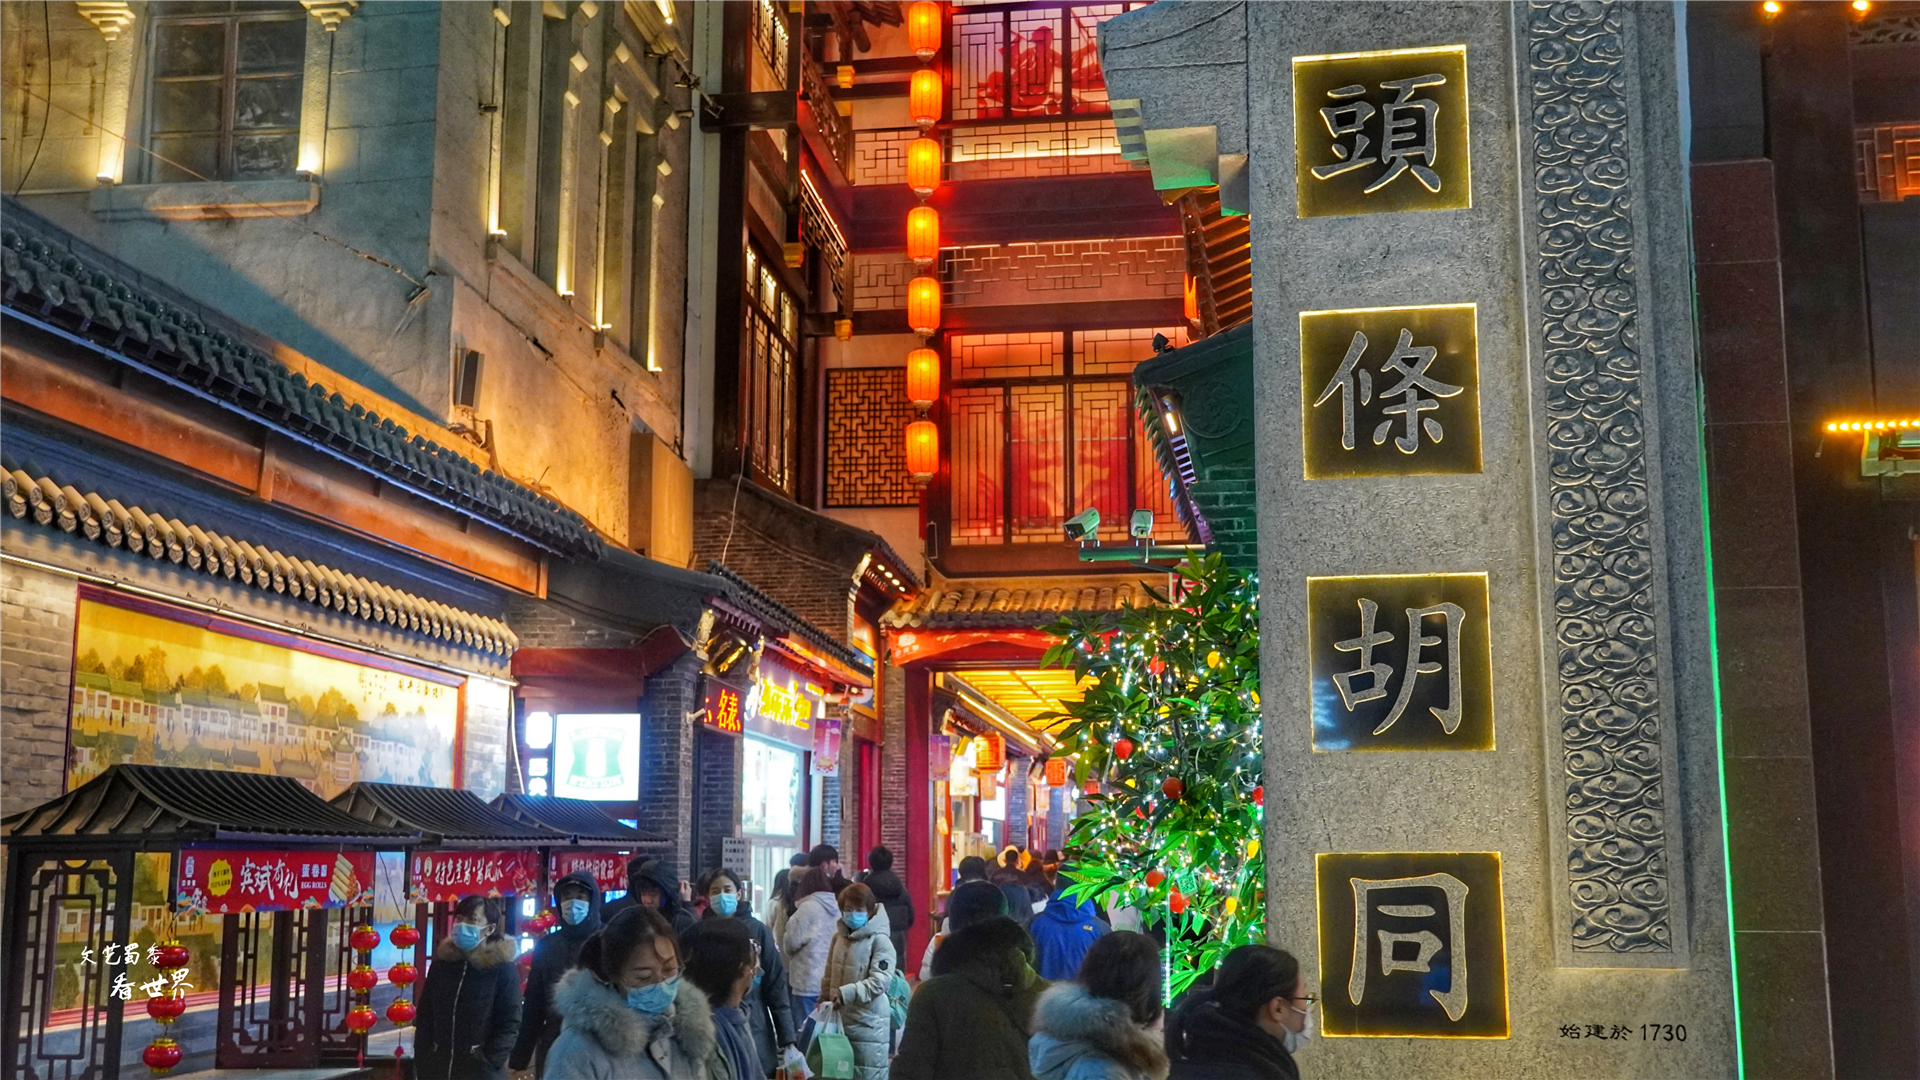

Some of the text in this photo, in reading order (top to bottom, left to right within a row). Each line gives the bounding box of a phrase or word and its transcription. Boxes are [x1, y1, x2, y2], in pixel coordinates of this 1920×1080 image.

[1310, 72, 1471, 1023] 頭條胡同
[301, 881, 311, 890] EGG
[1559, 1023, 1687, 1042] 始建於 1730
